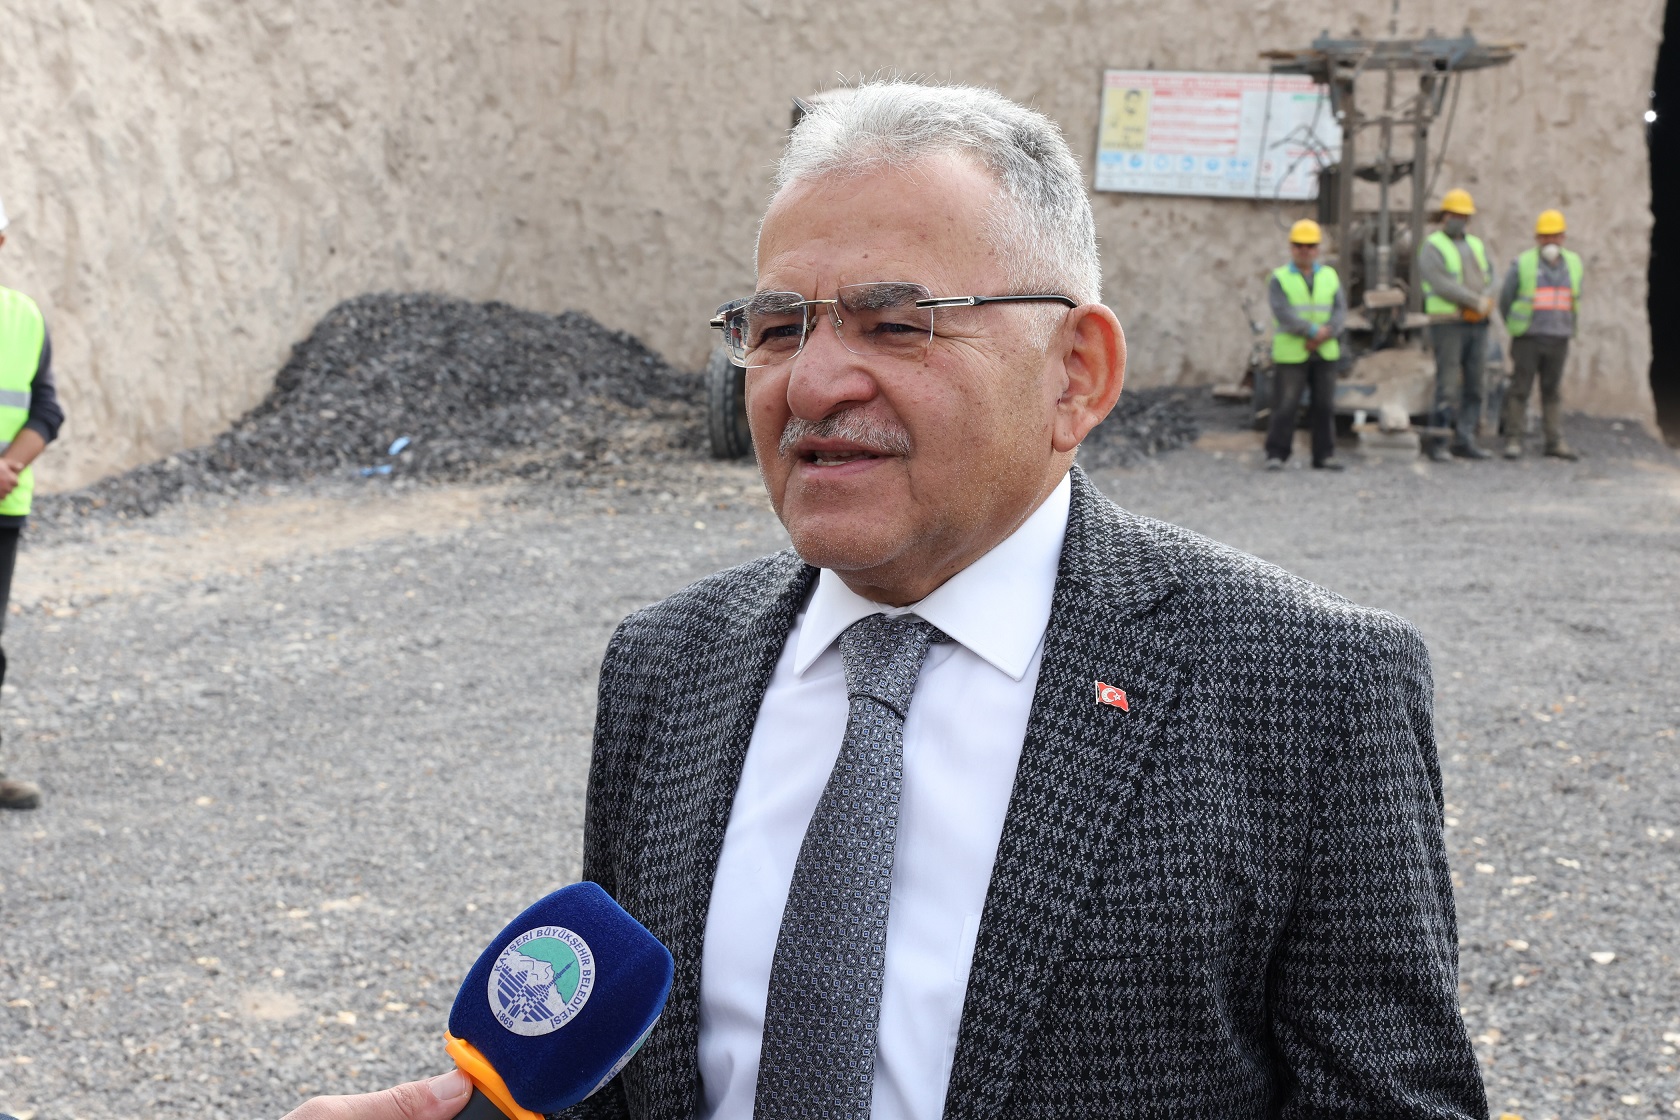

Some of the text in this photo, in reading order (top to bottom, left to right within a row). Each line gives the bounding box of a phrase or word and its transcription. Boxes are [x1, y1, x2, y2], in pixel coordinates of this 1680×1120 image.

[494, 927, 592, 1029] KAYSERİ BÜYÜKŞEHİR BELEDİYESİ
[495, 1010, 514, 1029] 1869
